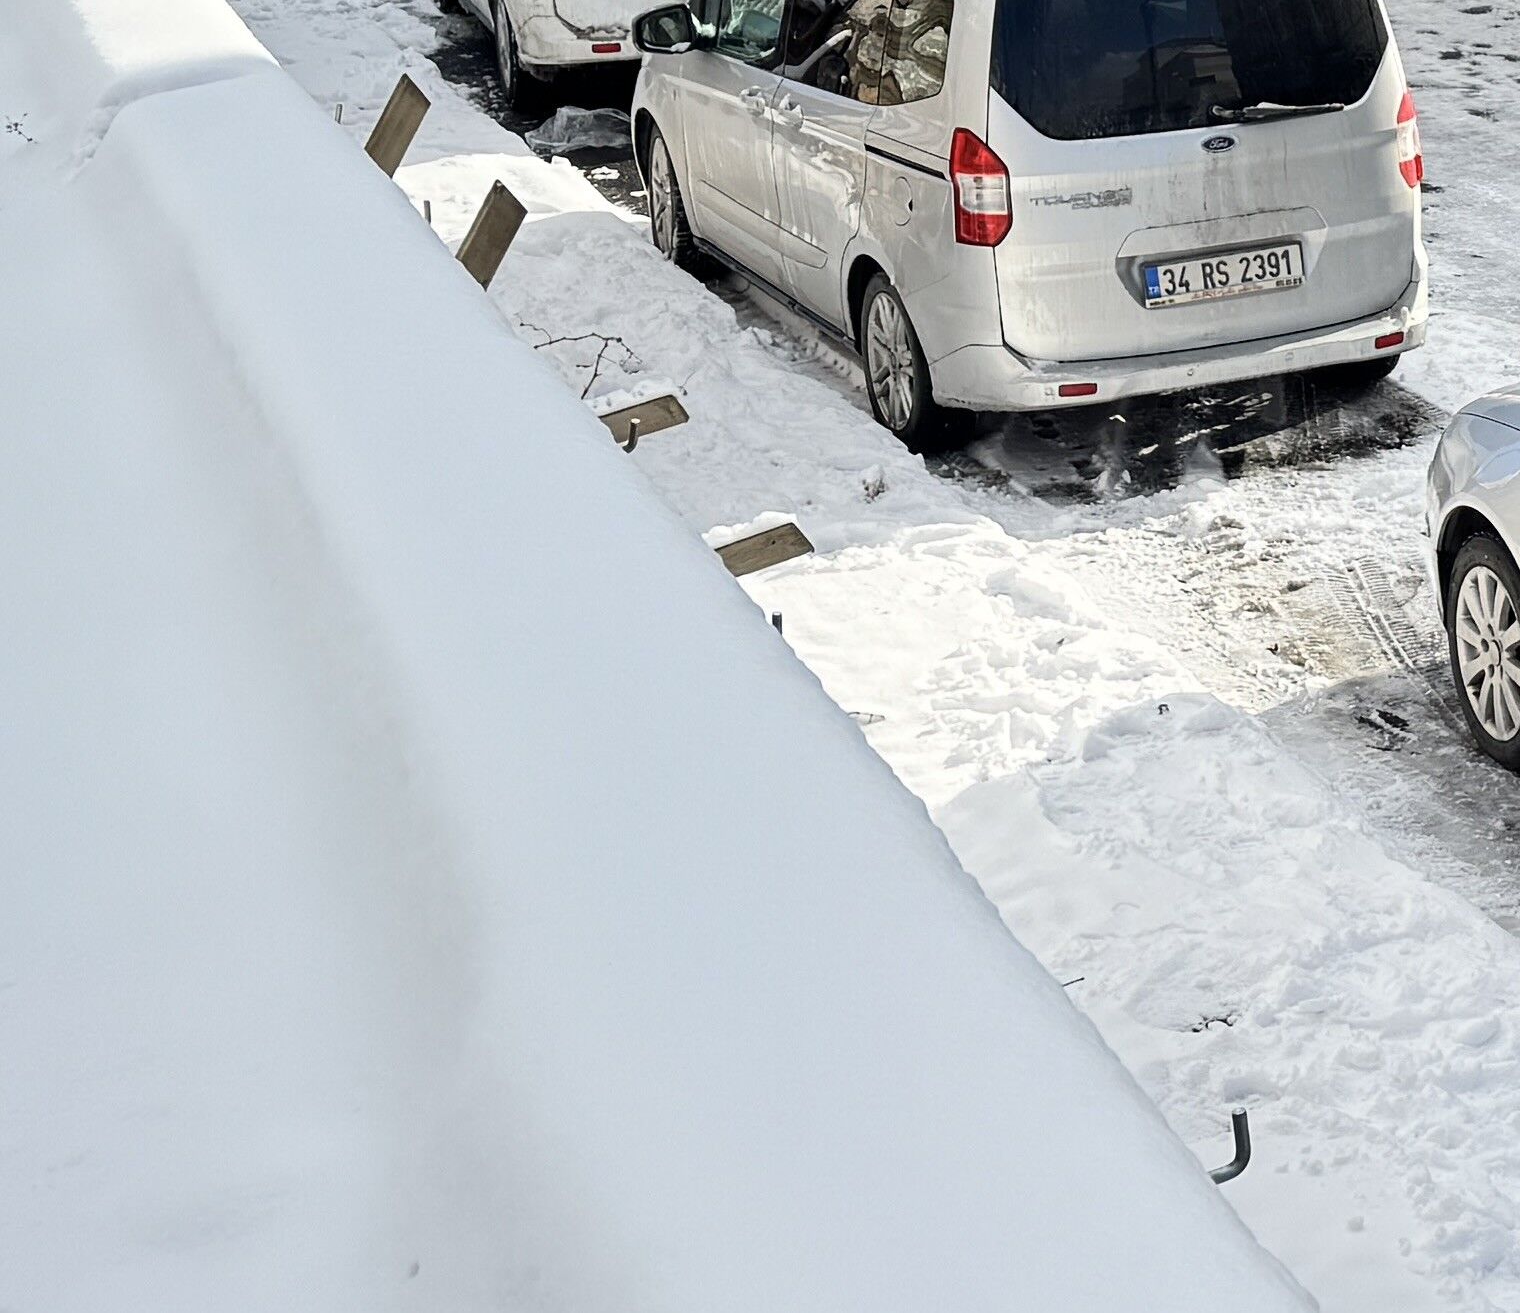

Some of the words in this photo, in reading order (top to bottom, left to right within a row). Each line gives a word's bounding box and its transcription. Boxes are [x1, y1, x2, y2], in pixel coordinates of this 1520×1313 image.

[1162, 265, 1191, 296] 34
[1201, 260, 1230, 290] RS
[1239, 249, 1292, 283] 2391
